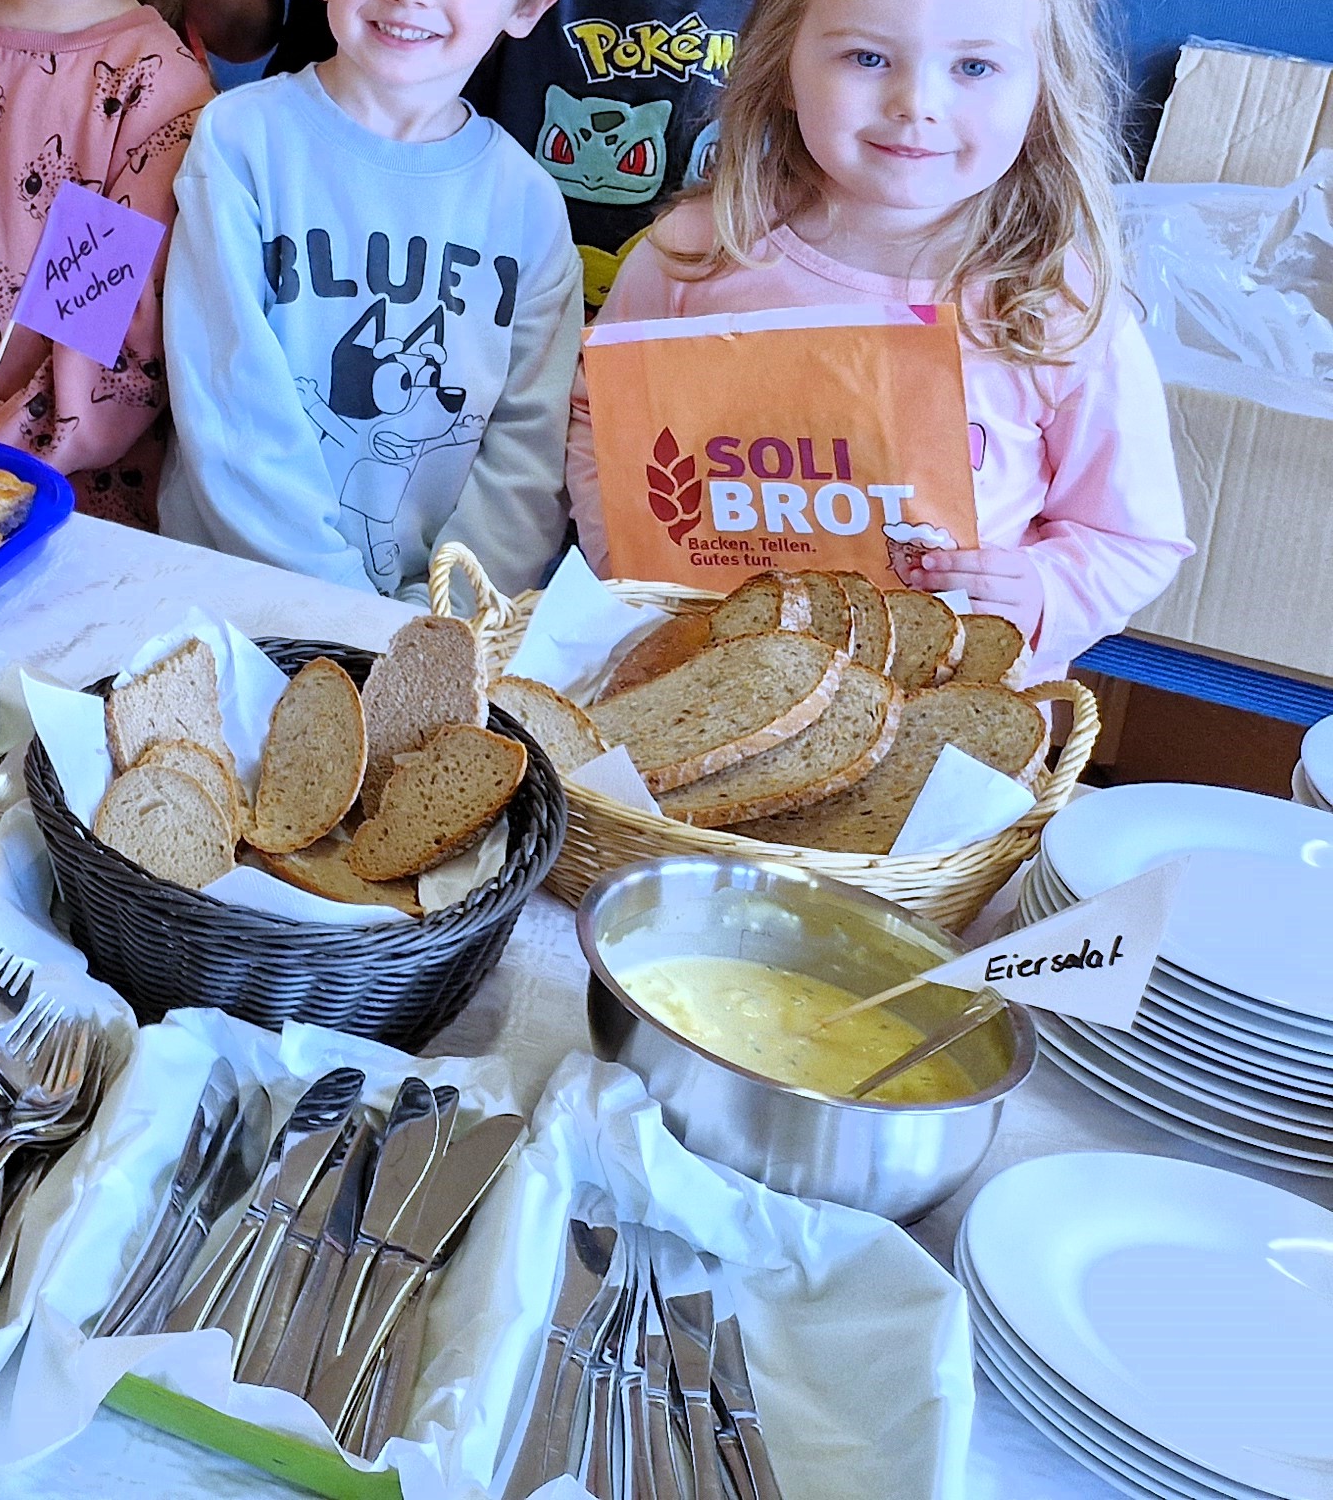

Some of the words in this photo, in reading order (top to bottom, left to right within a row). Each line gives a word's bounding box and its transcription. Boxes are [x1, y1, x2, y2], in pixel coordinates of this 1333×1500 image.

[45, 222, 116, 290] Apfel-
[704, 436, 852, 481] SOLI
[708, 480, 915, 536] BROT
[688, 537, 754, 552] Backen.
[758, 537, 817, 554] Teilen.
[690, 552, 739, 567] Gutes
[744, 553, 778, 568] tun.
[984, 935, 1124, 982] Eiersalat
